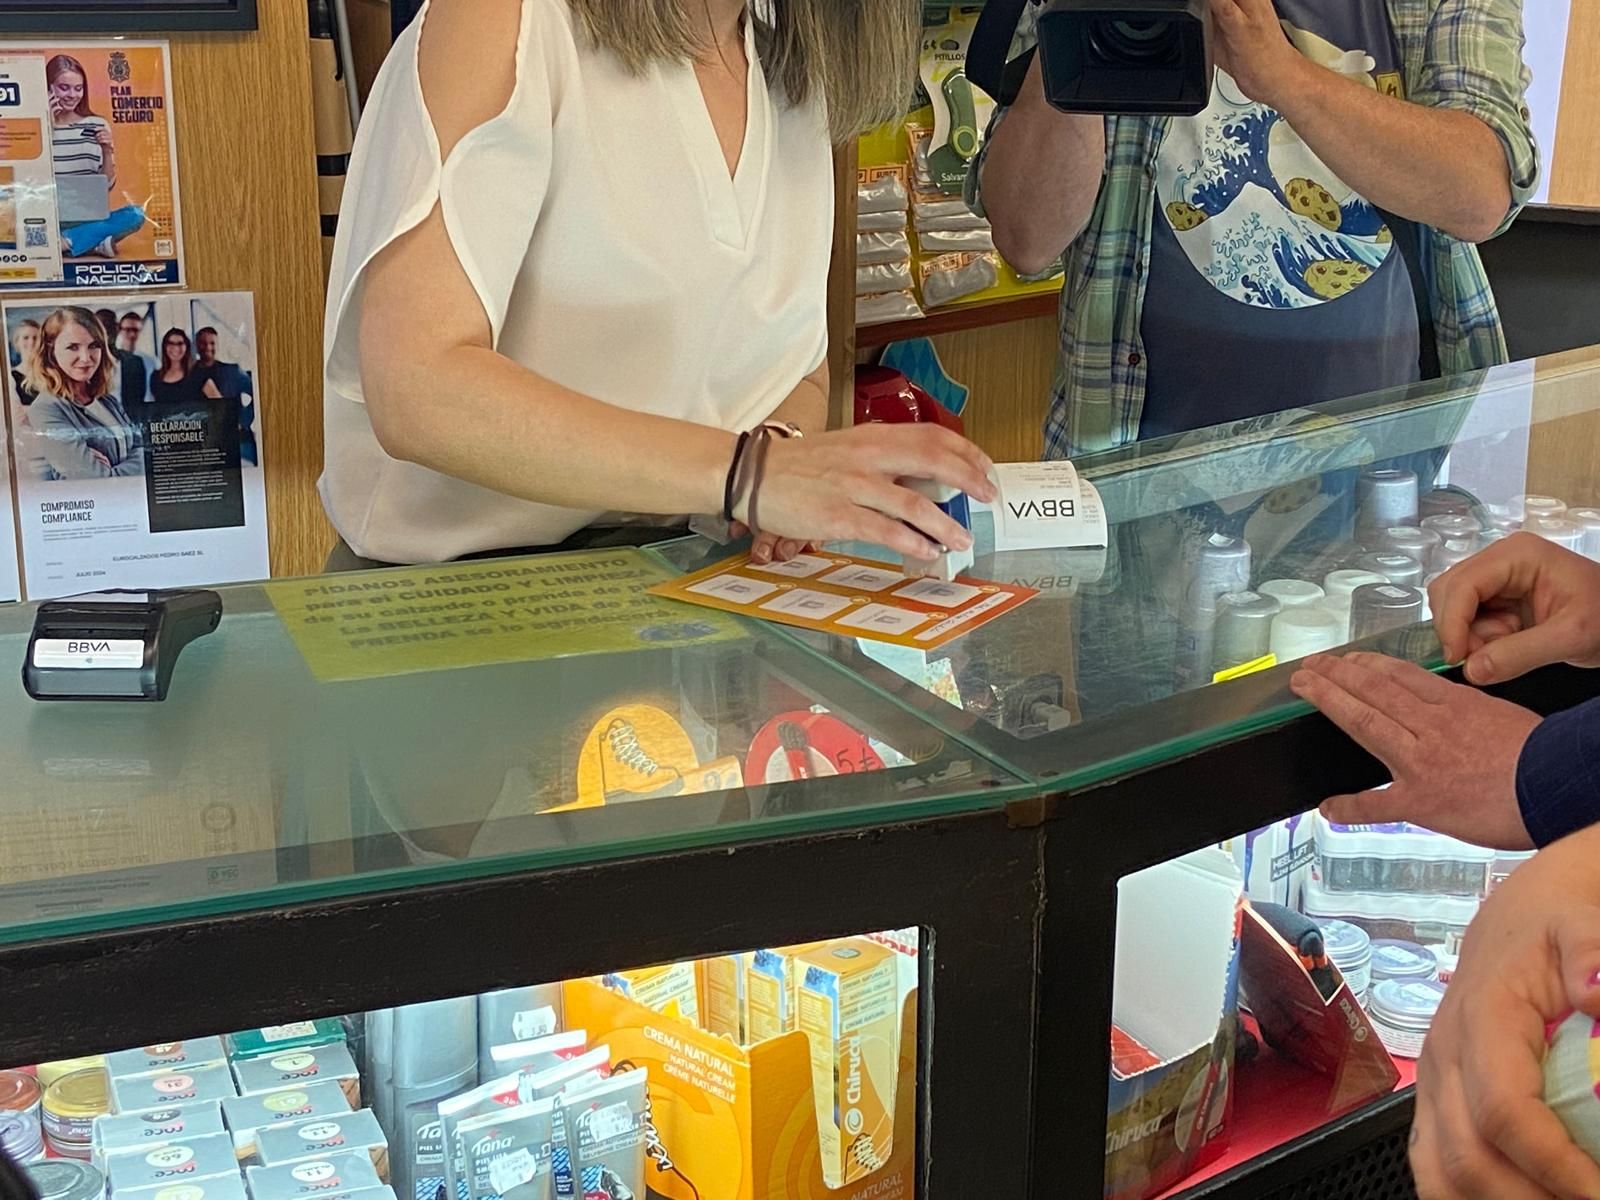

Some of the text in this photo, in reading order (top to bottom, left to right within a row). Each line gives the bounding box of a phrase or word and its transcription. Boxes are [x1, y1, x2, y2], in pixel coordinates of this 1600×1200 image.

[110, 86, 131, 96] PLAN
[111, 96, 163, 109] COMERCIO
[112, 110, 154, 123] SEGURO
[75, 264, 148, 274] POLICIA
[76, 274, 167, 285] NACIONAL
[151, 432, 204, 443] RESPONSABLE
[41, 500, 94, 513] COMPROMISO
[1008, 500, 1075, 519] BBVA
[42, 512, 92, 524] COMPLIANCE
[424, 558, 629, 585] ASESORAMIENTO
[305, 568, 655, 612] para el CUIDADO Y LIMPIEZA
[304, 615, 335, 624] de
[343, 611, 372, 620] su
[379, 600, 475, 616] calzado
[482, 599, 496, 607] o
[503, 588, 585, 607] prenda
[593, 585, 621, 596] de
[378, 612, 495, 631] BELLEZA
[501, 609, 518, 619] Y
[526, 603, 586, 617] VIDA
[593, 599, 621, 610] de
[629, 597, 657, 607] su
[350, 629, 457, 648] PRENDA
[465, 626, 492, 636] se
[67, 642, 111, 653] BBVA
[643, 1025, 735, 1078] CREMA NATURAL
[669, 1053, 736, 1091] NATURAL CREAM
[846, 1036, 861, 1104] Chiruca
[691, 1076, 736, 1104] NATURELLE
[471, 1135, 513, 1156] Tana
